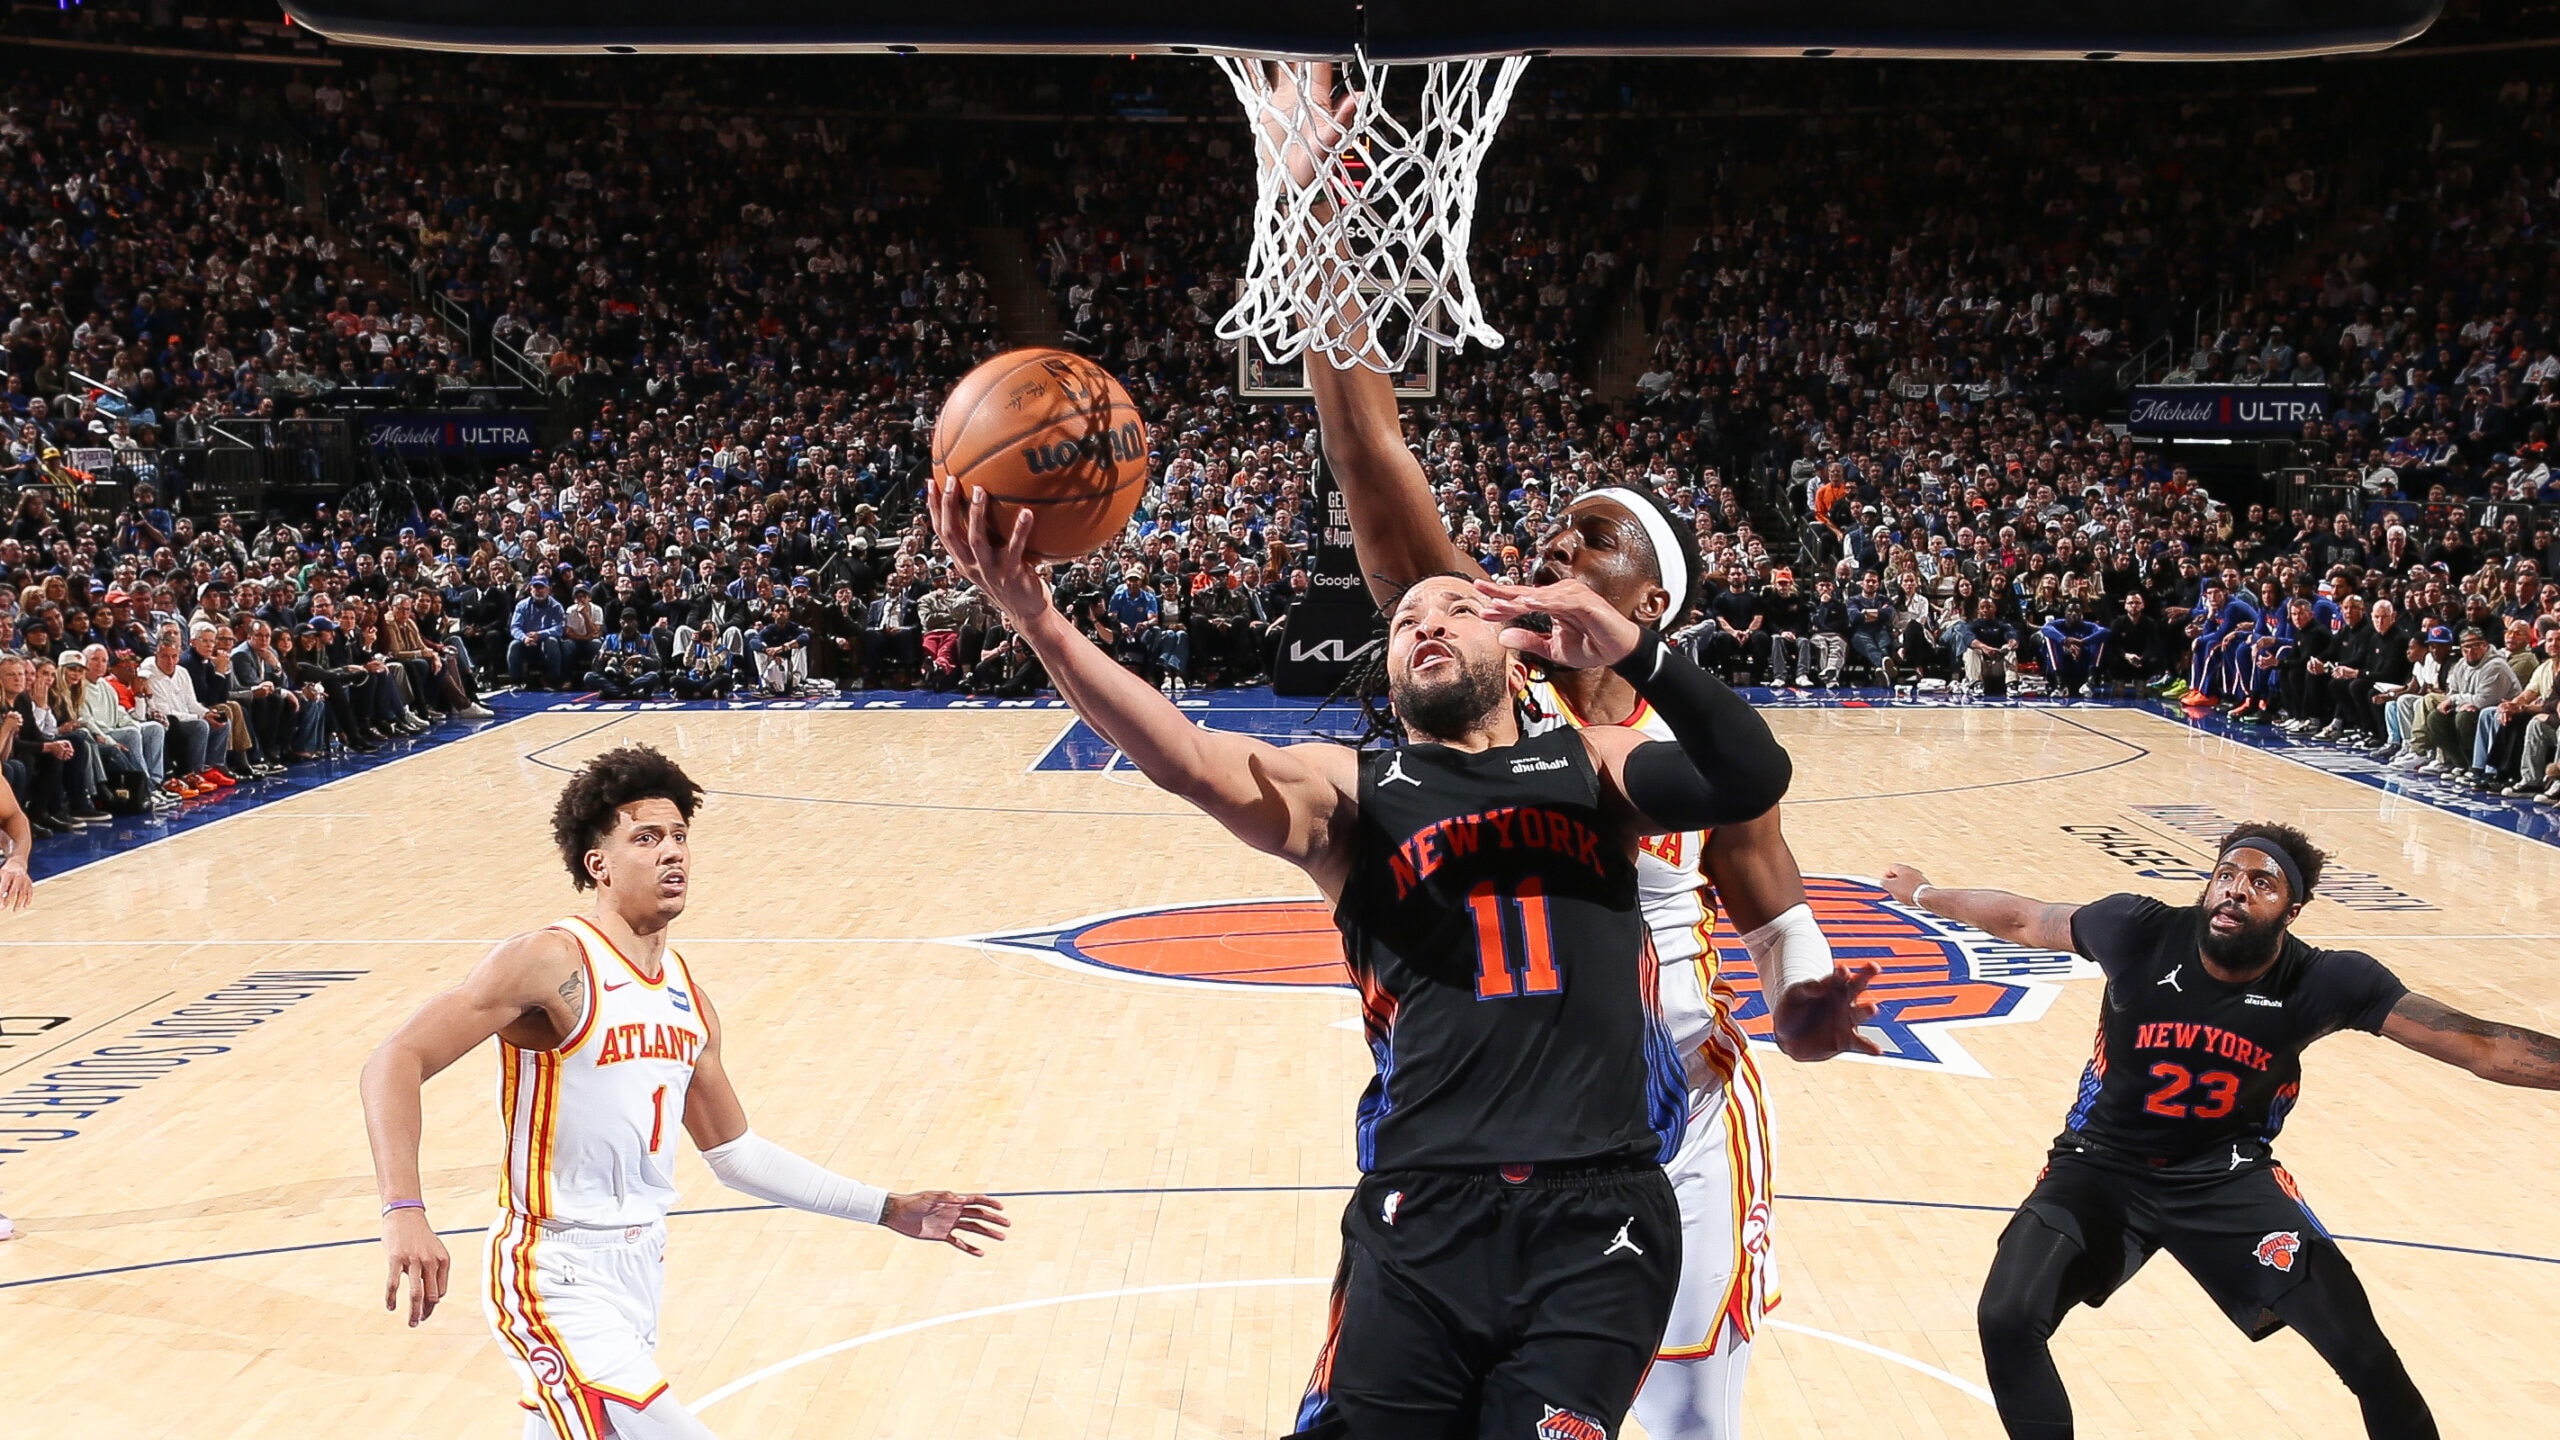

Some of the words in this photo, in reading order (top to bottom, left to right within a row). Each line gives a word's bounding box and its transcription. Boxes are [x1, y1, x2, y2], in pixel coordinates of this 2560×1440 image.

[2130, 400, 2213, 423] Michelob
[2239, 402, 2322, 420] ULTRA
[370, 425, 440, 445] Michelob
[462, 427, 529, 443] ULTRA
[1328, 509, 1348, 526] THE
[1333, 528, 1353, 548] App
[1314, 573, 1361, 589] Google
[547, 702, 686, 711] NEW
[728, 701, 908, 711] YORK
[947, 700, 1210, 708] KNIS
[1388, 812, 1483, 901] NEW
[1484, 805, 1606, 877] YORK
[2060, 824, 2193, 867] CHASE
[1465, 877, 1564, 1001] 11
[123, 969, 371, 1039] MADISON
[594, 1023, 699, 1069] ATLANT
[2134, 1021, 2202, 1049] NEW
[2202, 1025, 2273, 1072] YORK
[2143, 1060, 2242, 1119] 23
[649, 1084, 668, 1154] 1
